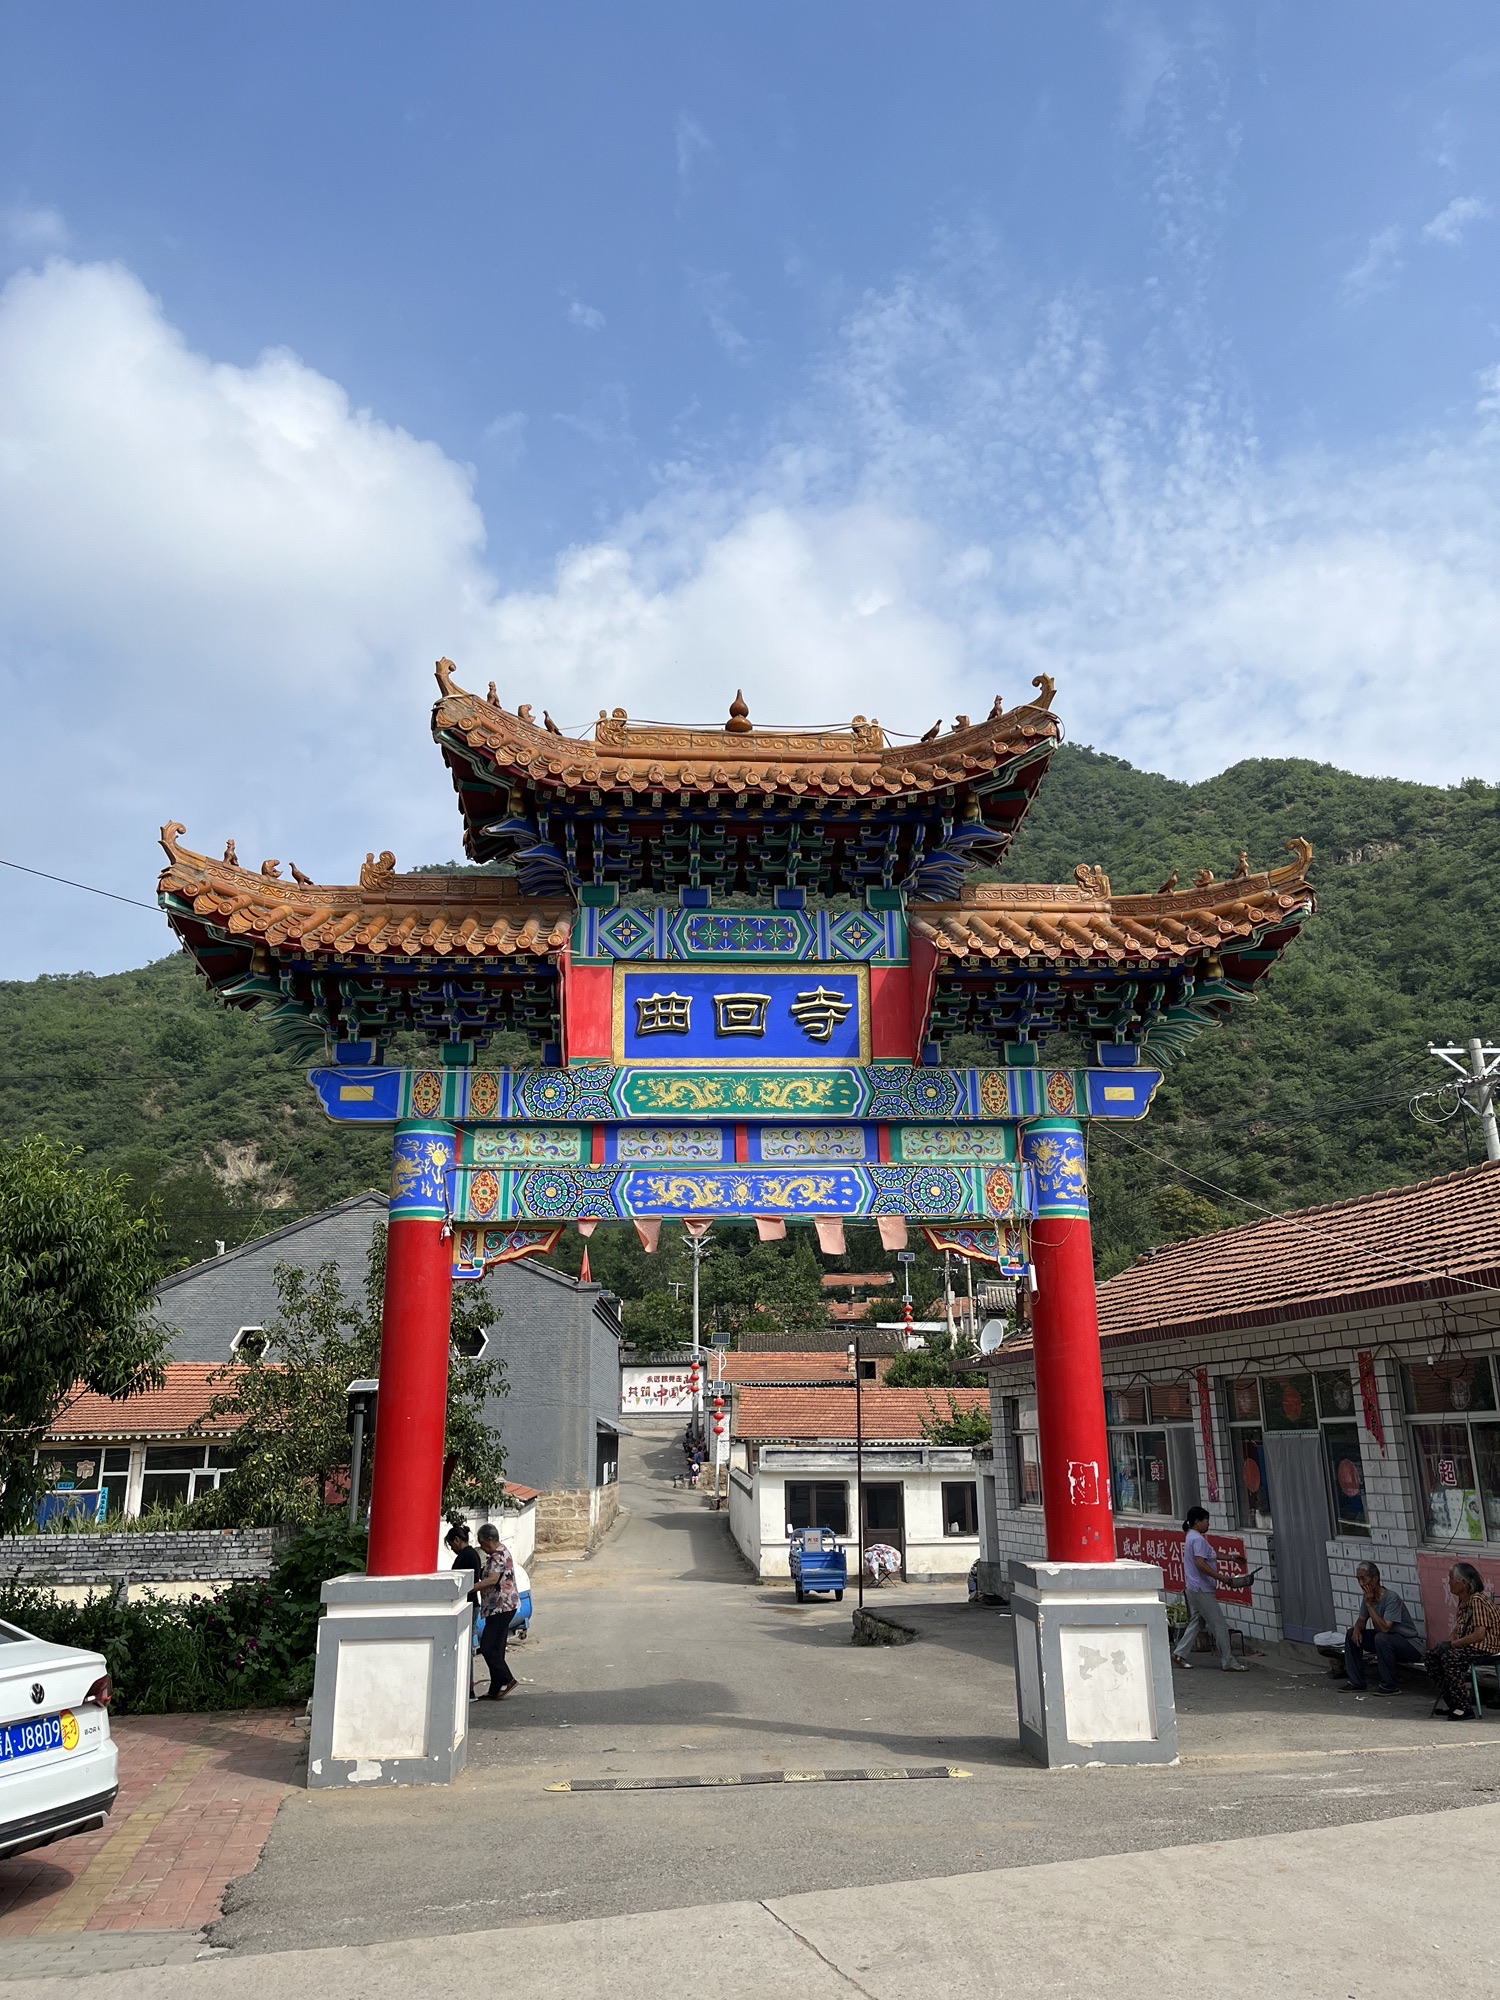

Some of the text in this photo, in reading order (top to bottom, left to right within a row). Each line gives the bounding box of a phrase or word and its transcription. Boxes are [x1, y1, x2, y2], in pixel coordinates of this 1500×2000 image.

[637, 985, 853, 1042] 曲回寺
[1438, 1459, 1457, 1487] 超
